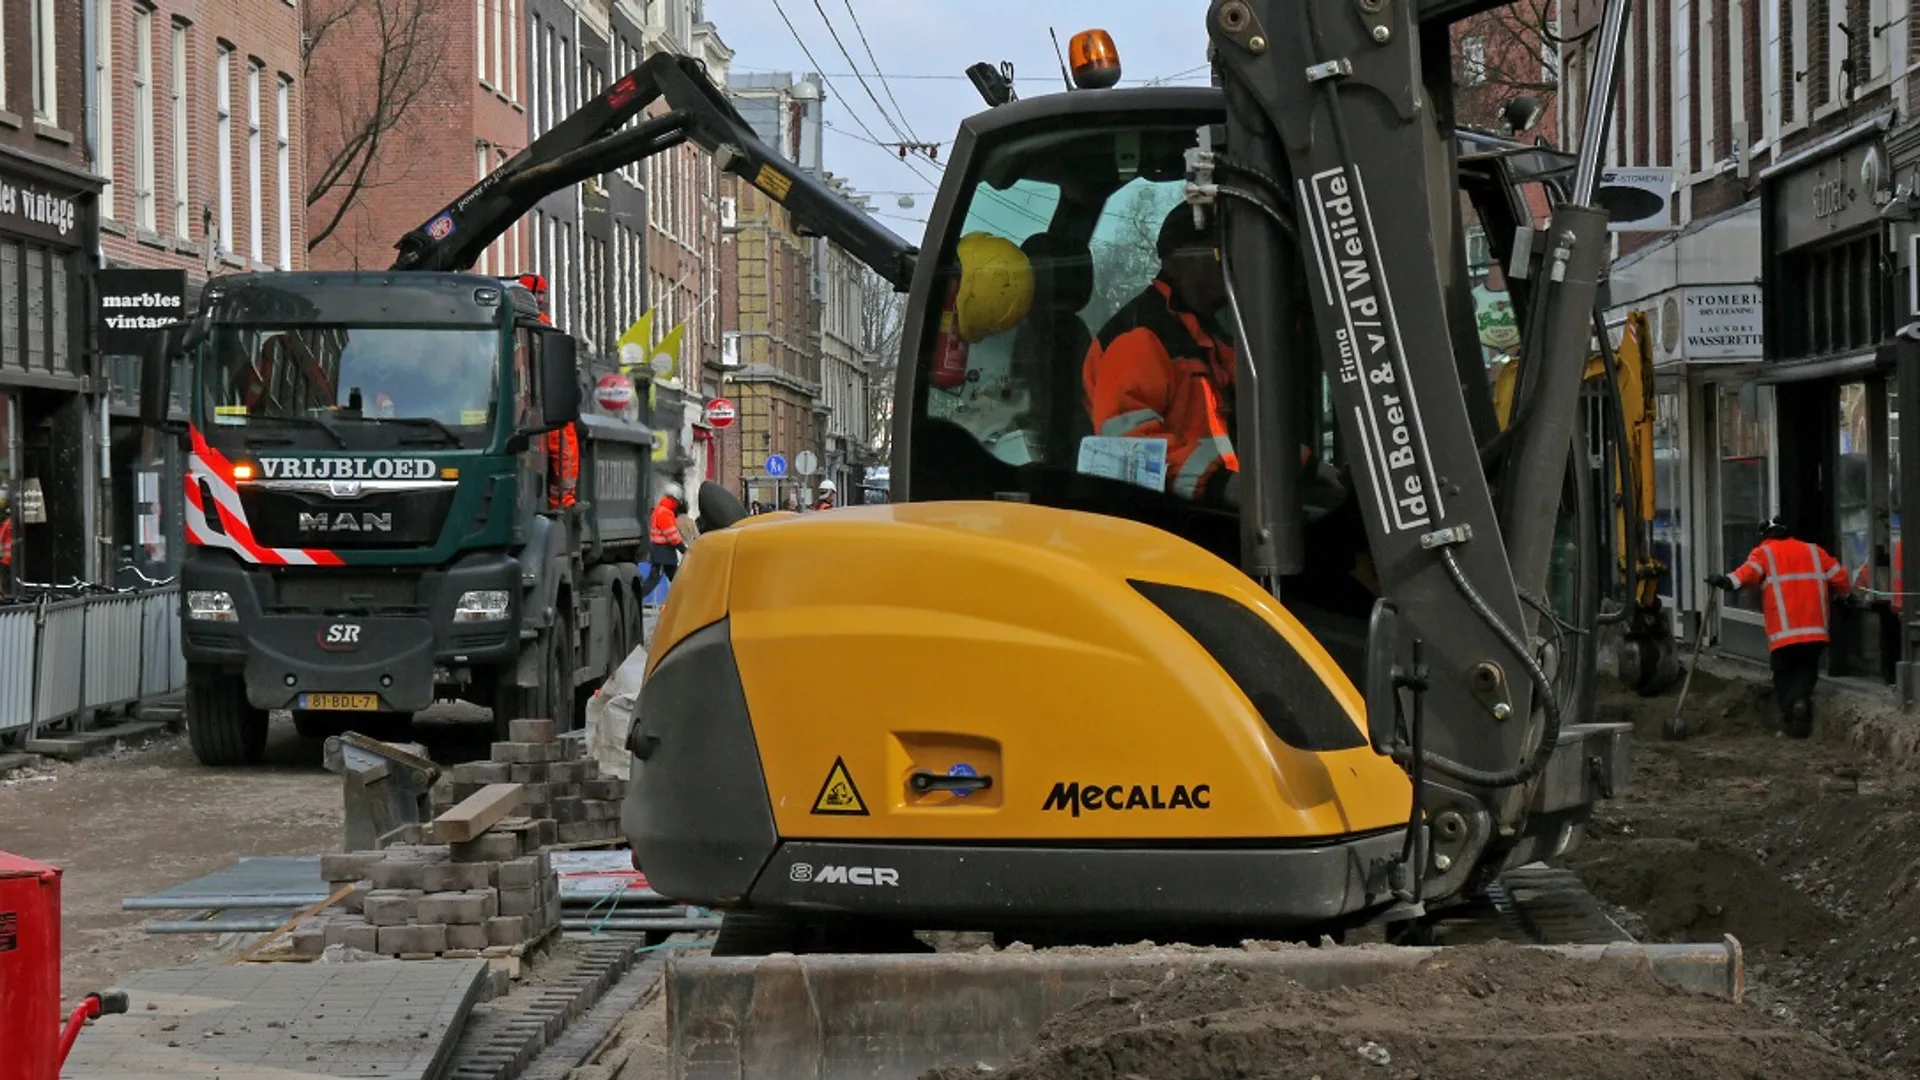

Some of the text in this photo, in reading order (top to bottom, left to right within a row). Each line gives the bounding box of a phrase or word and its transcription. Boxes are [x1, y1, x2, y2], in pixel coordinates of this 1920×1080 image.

[21, 184, 74, 235] vintage
[102, 292, 181, 308] marbles
[1687, 294, 1763, 306] STOMERI
[1716, 307, 1754, 316] CLEANING
[1350, 295, 1387, 354] v/d
[1700, 325, 1754, 334] LAUNDRY
[1336, 329, 1358, 384] Firma
[1370, 361, 1395, 384] &
[1383, 394, 1415, 469] Boer
[259, 458, 436, 478] VRIJBLOED
[1399, 475, 1428, 516] de
[299, 512, 392, 532] MAN
[327, 624, 361, 642] SR
[312, 693, 371, 708] 81-BDL-7
